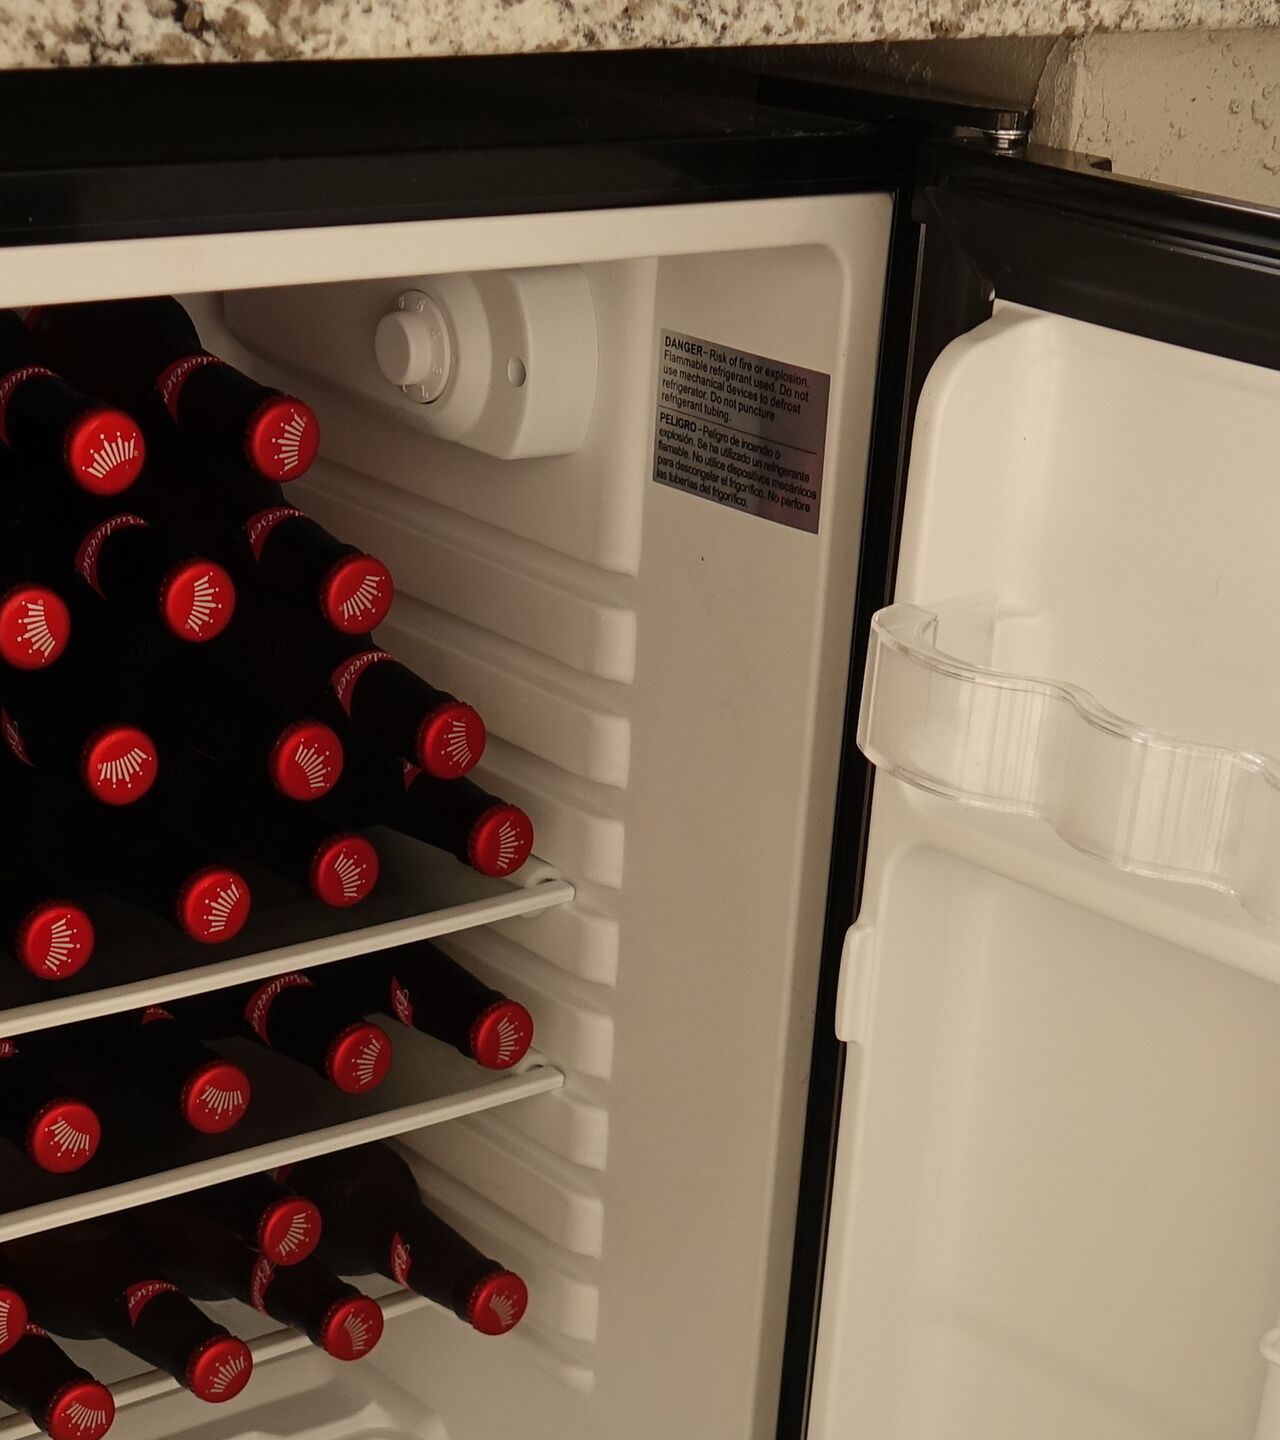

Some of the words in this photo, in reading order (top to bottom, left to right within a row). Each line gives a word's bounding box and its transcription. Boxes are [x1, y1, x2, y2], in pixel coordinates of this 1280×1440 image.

[664, 349, 708, 372] Flammable
[710, 363, 752, 387] refrigerant
[754, 377, 777, 392] used.
[780, 384, 792, 397] Do
[794, 390, 809, 402] not
[665, 336, 703, 357] DANGER
[709, 349, 727, 364] Risk
[729, 356, 738, 367] of
[739, 358, 752, 371] fire
[754, 363, 763, 374] or
[765, 366, 809, 388] explosion.
[661, 391, 703, 412] refrigerant
[704, 402, 731, 423] tubing.
[663, 365, 677, 376] use
[679, 370, 725, 391] mechanical
[726, 382, 758, 401] devices
[760, 394, 768, 405] to
[770, 397, 801, 414] defrost
[710, 391, 722, 403] Do
[724, 397, 736, 408] not
[738, 402, 775, 421] puncture
[660, 413, 697, 433] PELIGRO
[703, 425, 728, 444] Peligro
[730, 435, 740, 446] de
[741, 438, 773, 457] incendio
[692, 451, 703, 463] No
[656, 468, 667, 479] las
[699, 483, 711, 494] del
[697, 438, 708, 451] Se
[709, 442, 719, 454] ha
[720, 446, 751, 465] utilizado
[752, 457, 762, 468] un
[763, 461, 810, 483] refrigerante
[657, 456, 674, 469] para
[676, 461, 719, 482] descongelar
[721, 475, 728, 486] el
[768, 491, 779, 503] No
[781, 495, 811, 513] perfore
